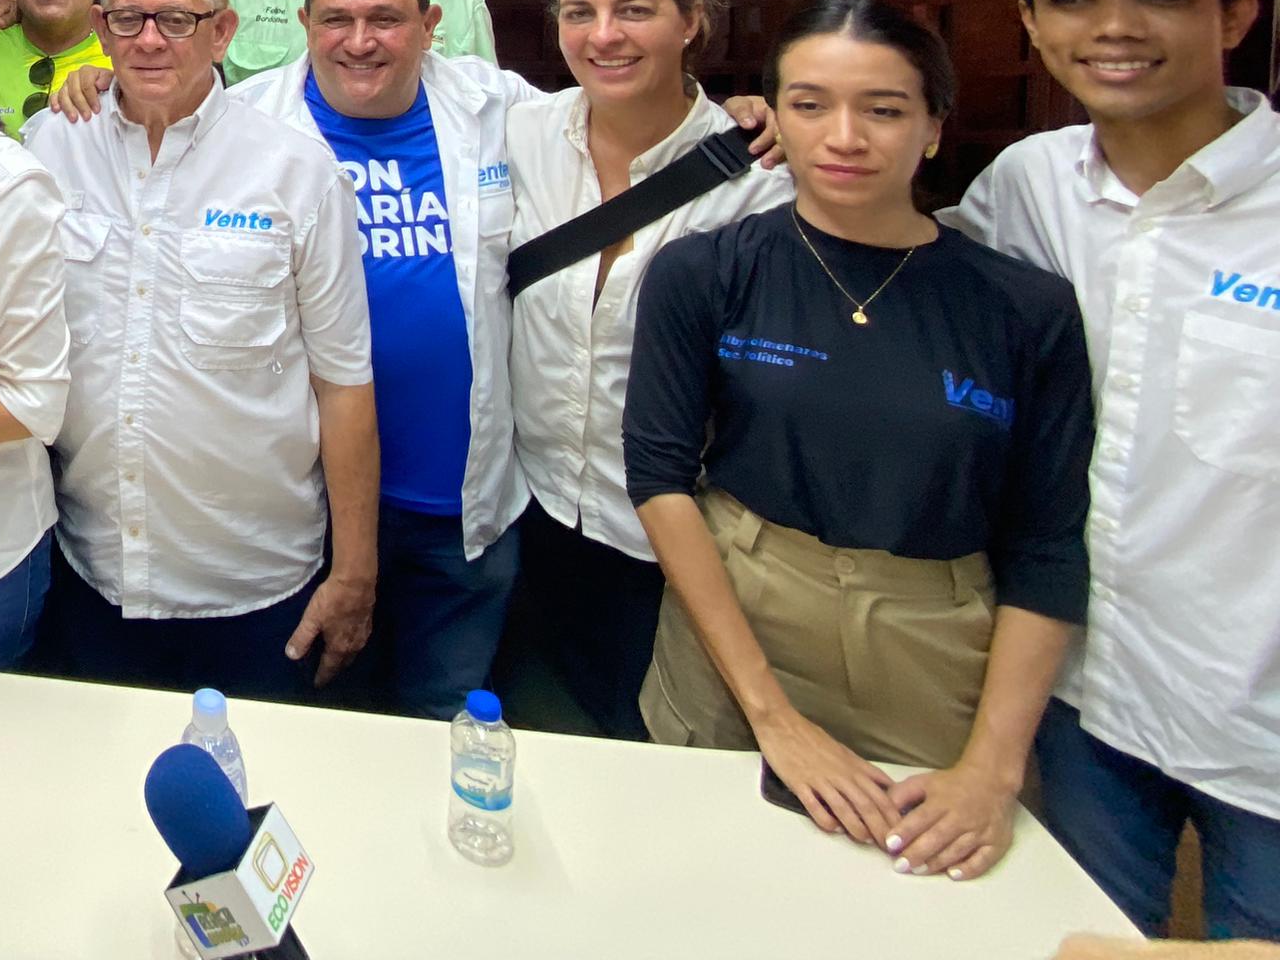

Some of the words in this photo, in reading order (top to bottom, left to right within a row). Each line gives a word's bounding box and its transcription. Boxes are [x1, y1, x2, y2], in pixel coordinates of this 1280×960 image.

[338, 159, 403, 191] ON
[479, 161, 509, 182] ente
[205, 208, 273, 230] Vente
[356, 187, 450, 224] ARÍA
[358, 224, 454, 258] RIN
[942, 369, 1015, 420] Ven
